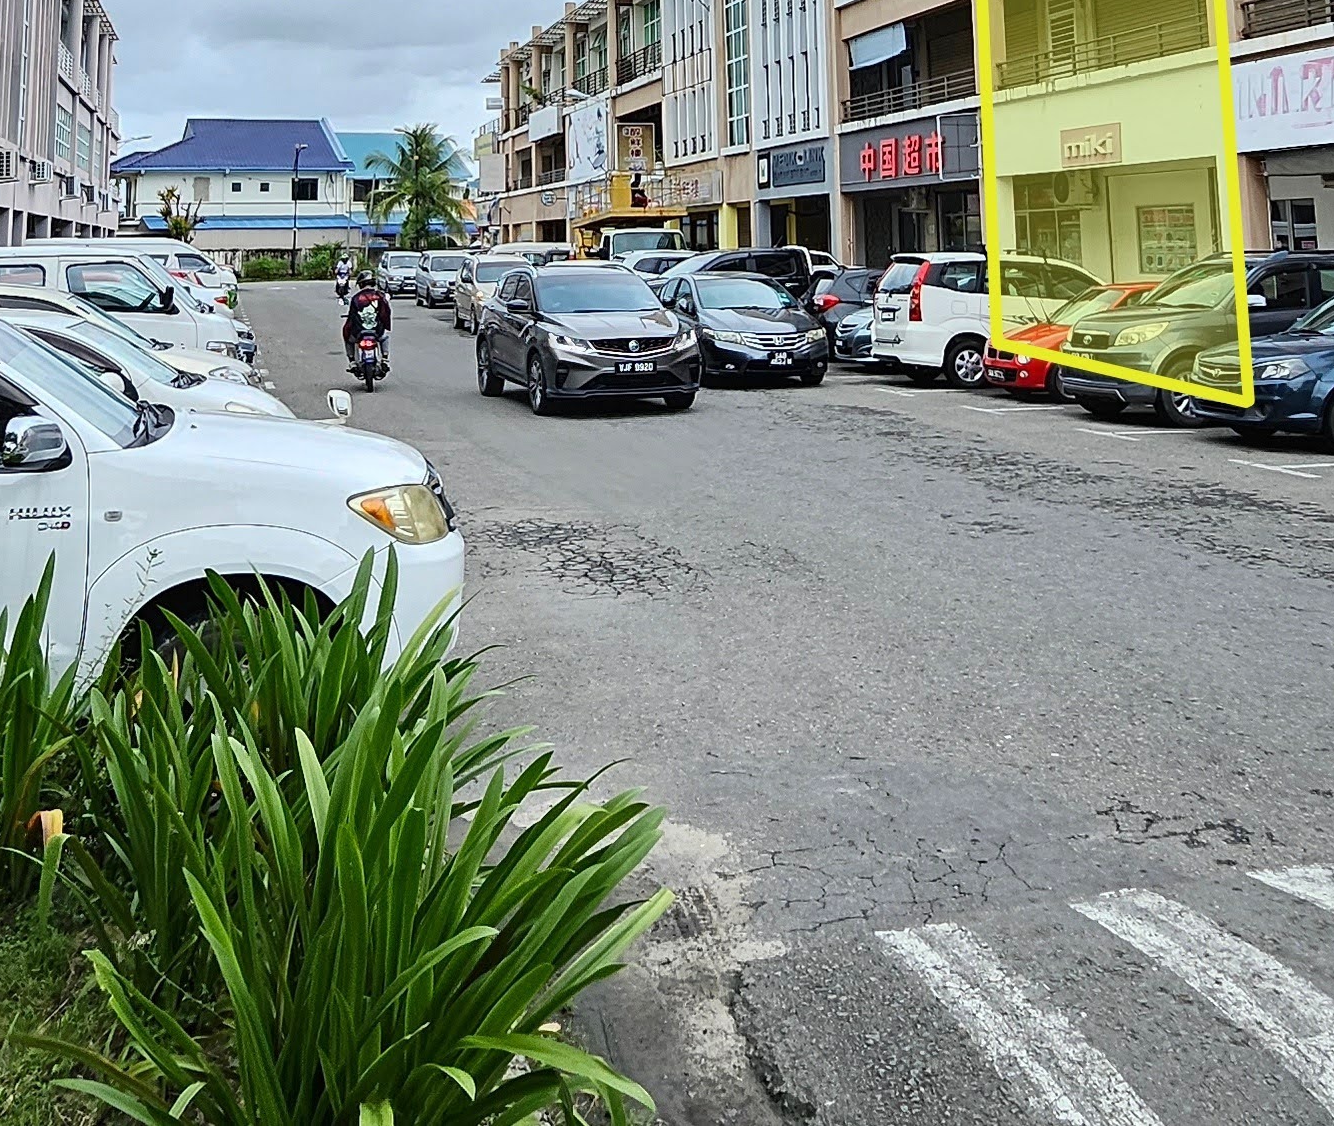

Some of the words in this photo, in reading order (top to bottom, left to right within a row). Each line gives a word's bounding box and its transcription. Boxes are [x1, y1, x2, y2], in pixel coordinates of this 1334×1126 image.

[859, 130, 944, 183] 中国超市
[1063, 132, 1114, 160] miki
[8, 505, 72, 520] HILUX
